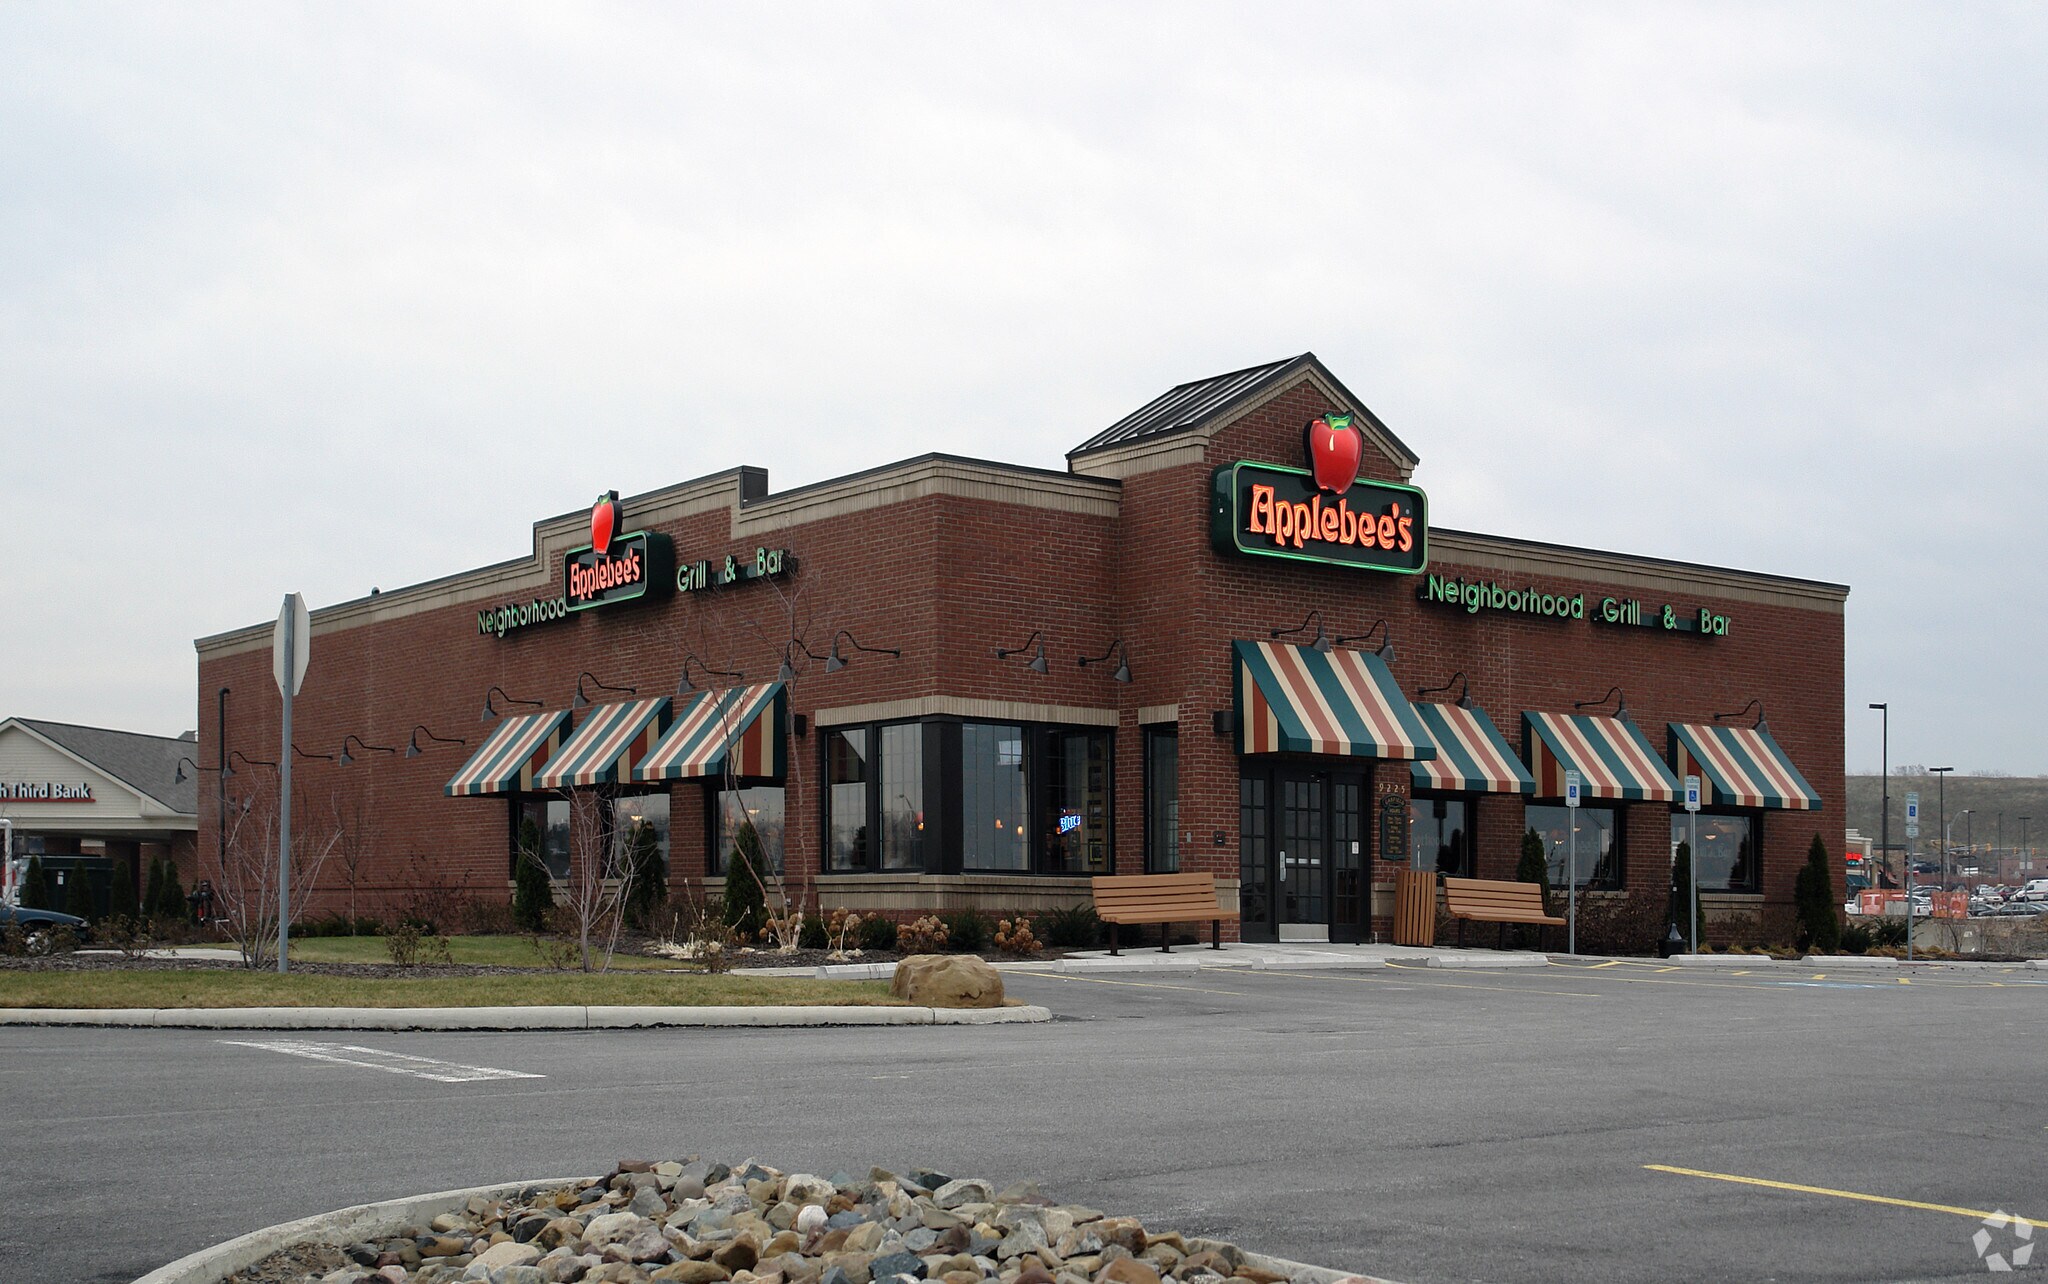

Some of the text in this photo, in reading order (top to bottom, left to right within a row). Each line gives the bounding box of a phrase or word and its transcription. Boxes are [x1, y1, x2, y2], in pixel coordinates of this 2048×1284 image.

[1248, 483, 1413, 553] Applebee's
[570, 548, 640, 600] Applebee's
[677, 547, 786, 592] Grill & Bar
[477, 597, 566, 638] Neighborhood
[1428, 574, 1733, 637] Neighborhood Grill & Bar
[9, 782, 49, 798] Third
[53, 783, 91, 798] Bank
[1380, 783, 1405, 794] 9225
